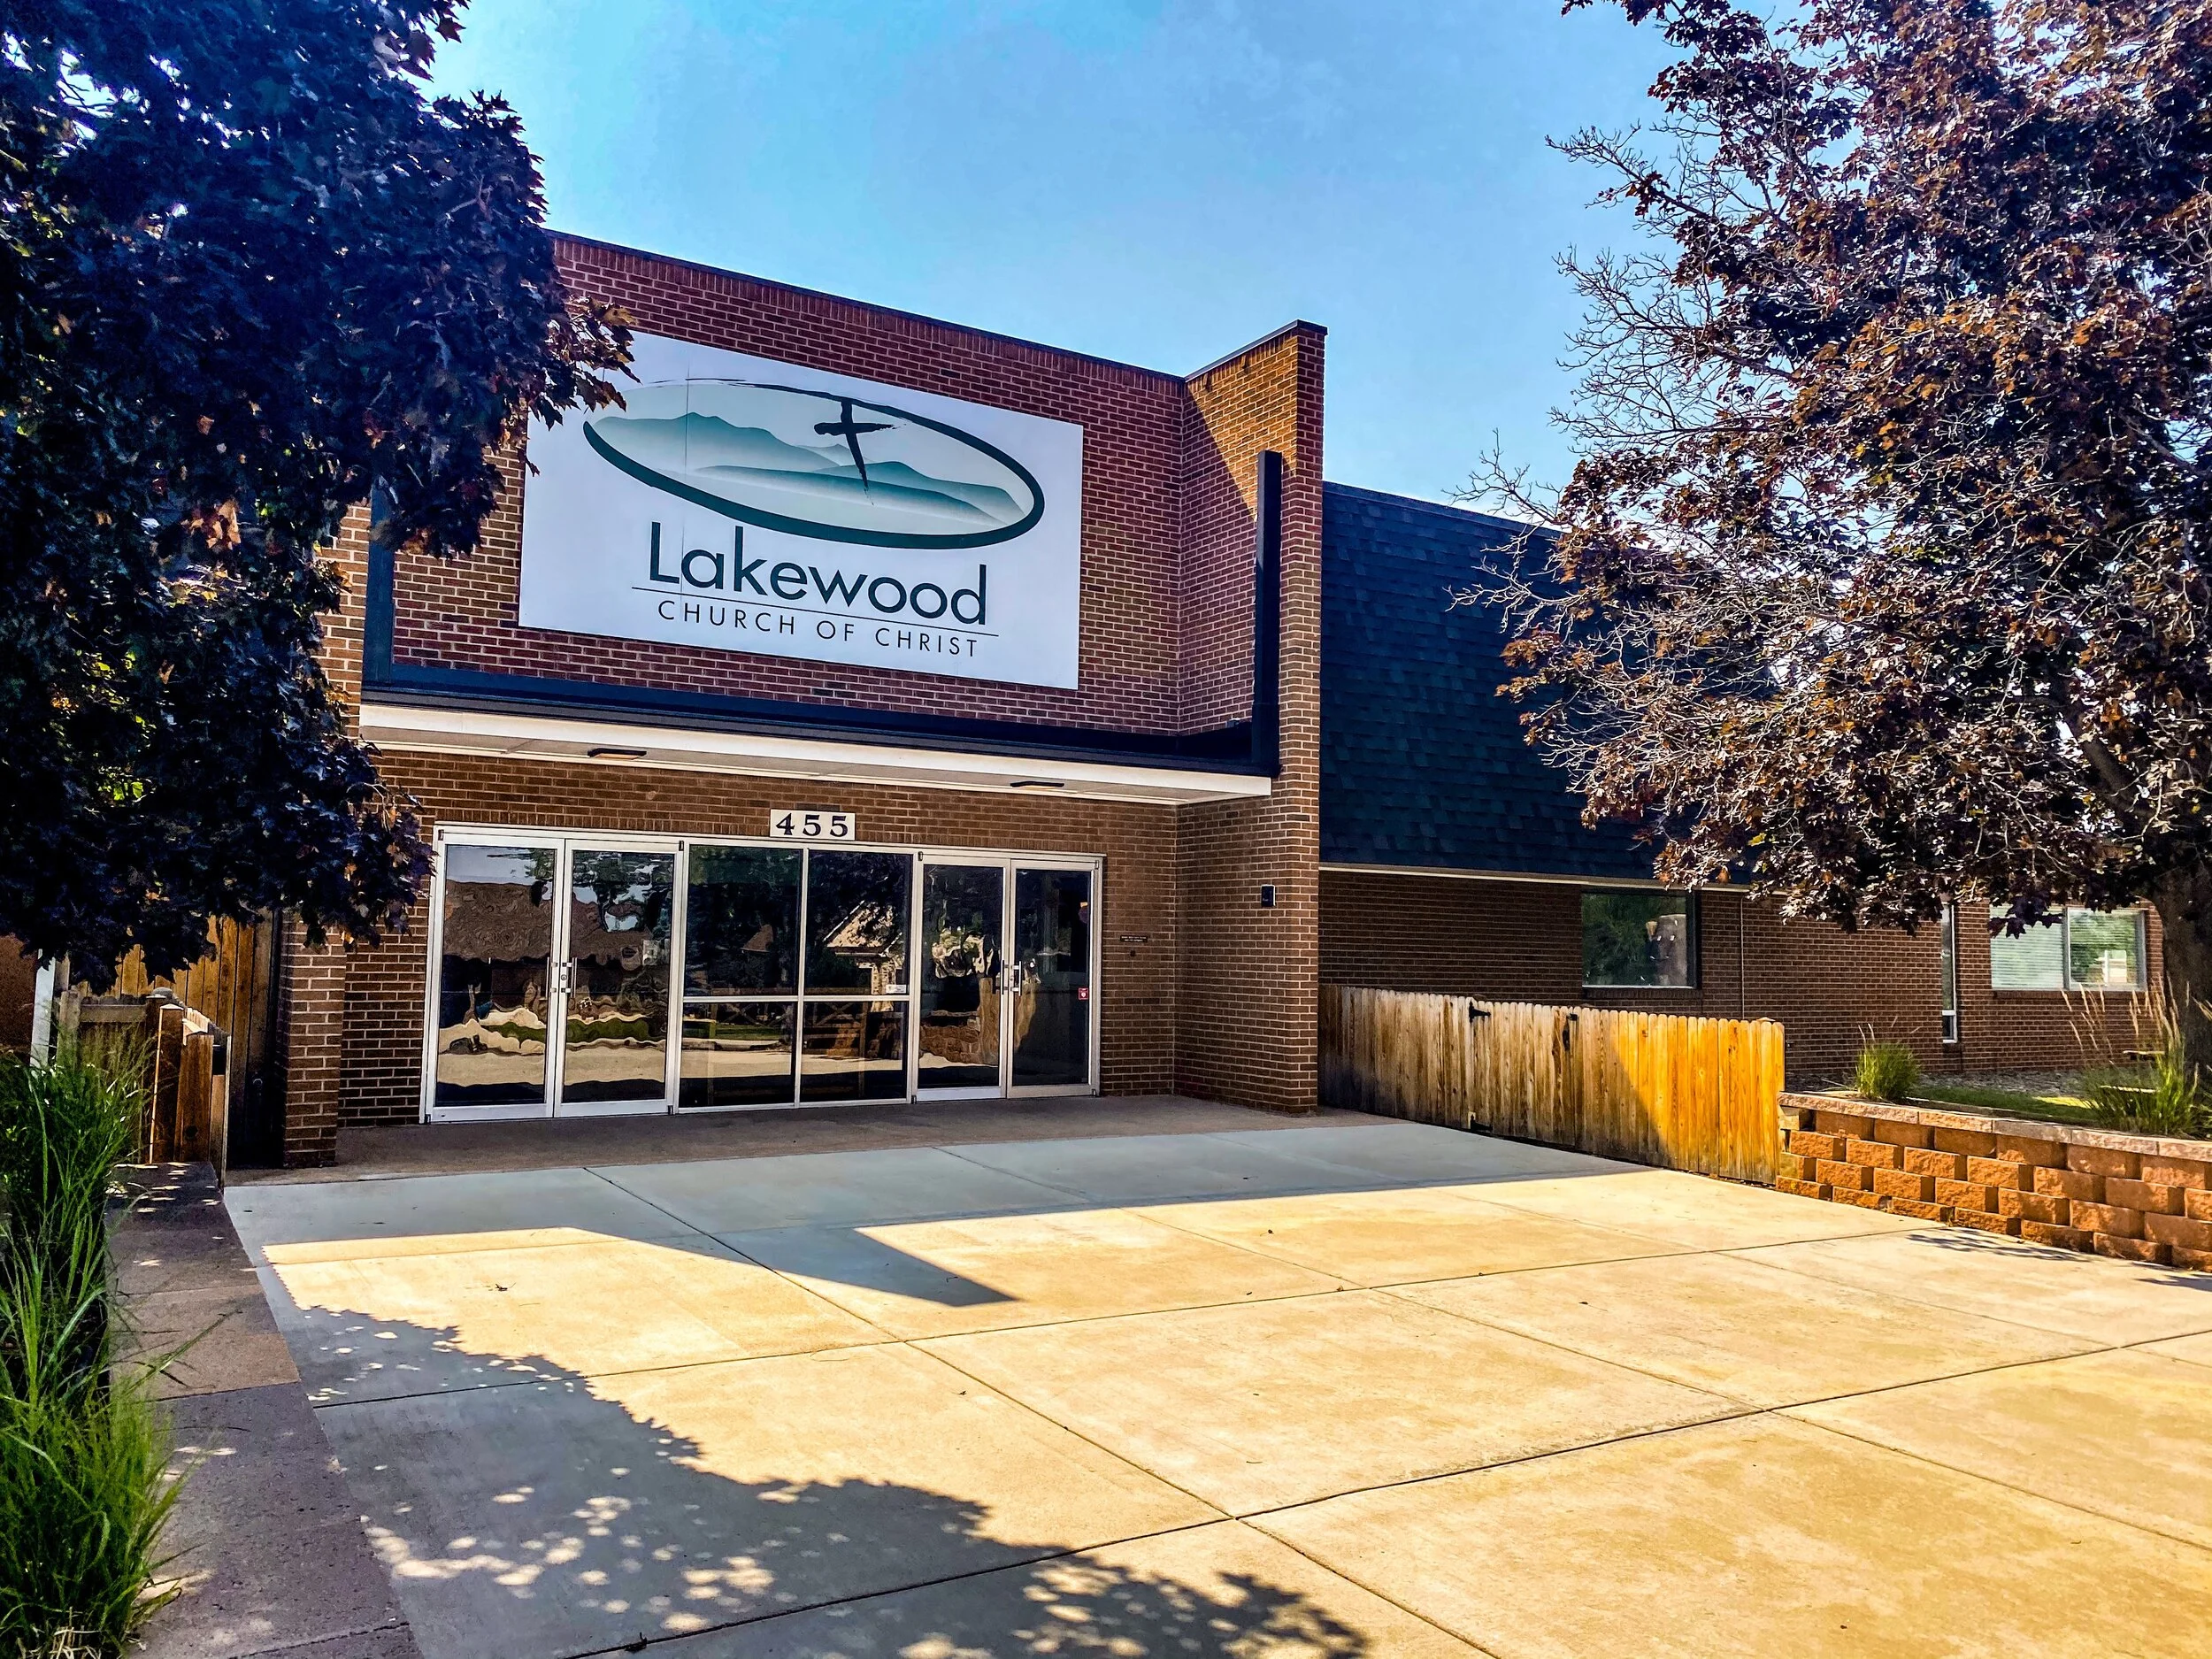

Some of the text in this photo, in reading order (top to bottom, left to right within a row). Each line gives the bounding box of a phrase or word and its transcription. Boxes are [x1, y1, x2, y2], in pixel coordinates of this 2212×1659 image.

[649, 521, 987, 625] Lakewood
[657, 600, 978, 657] CHURCH OF CHRIST
[776, 813, 849, 837] 455
